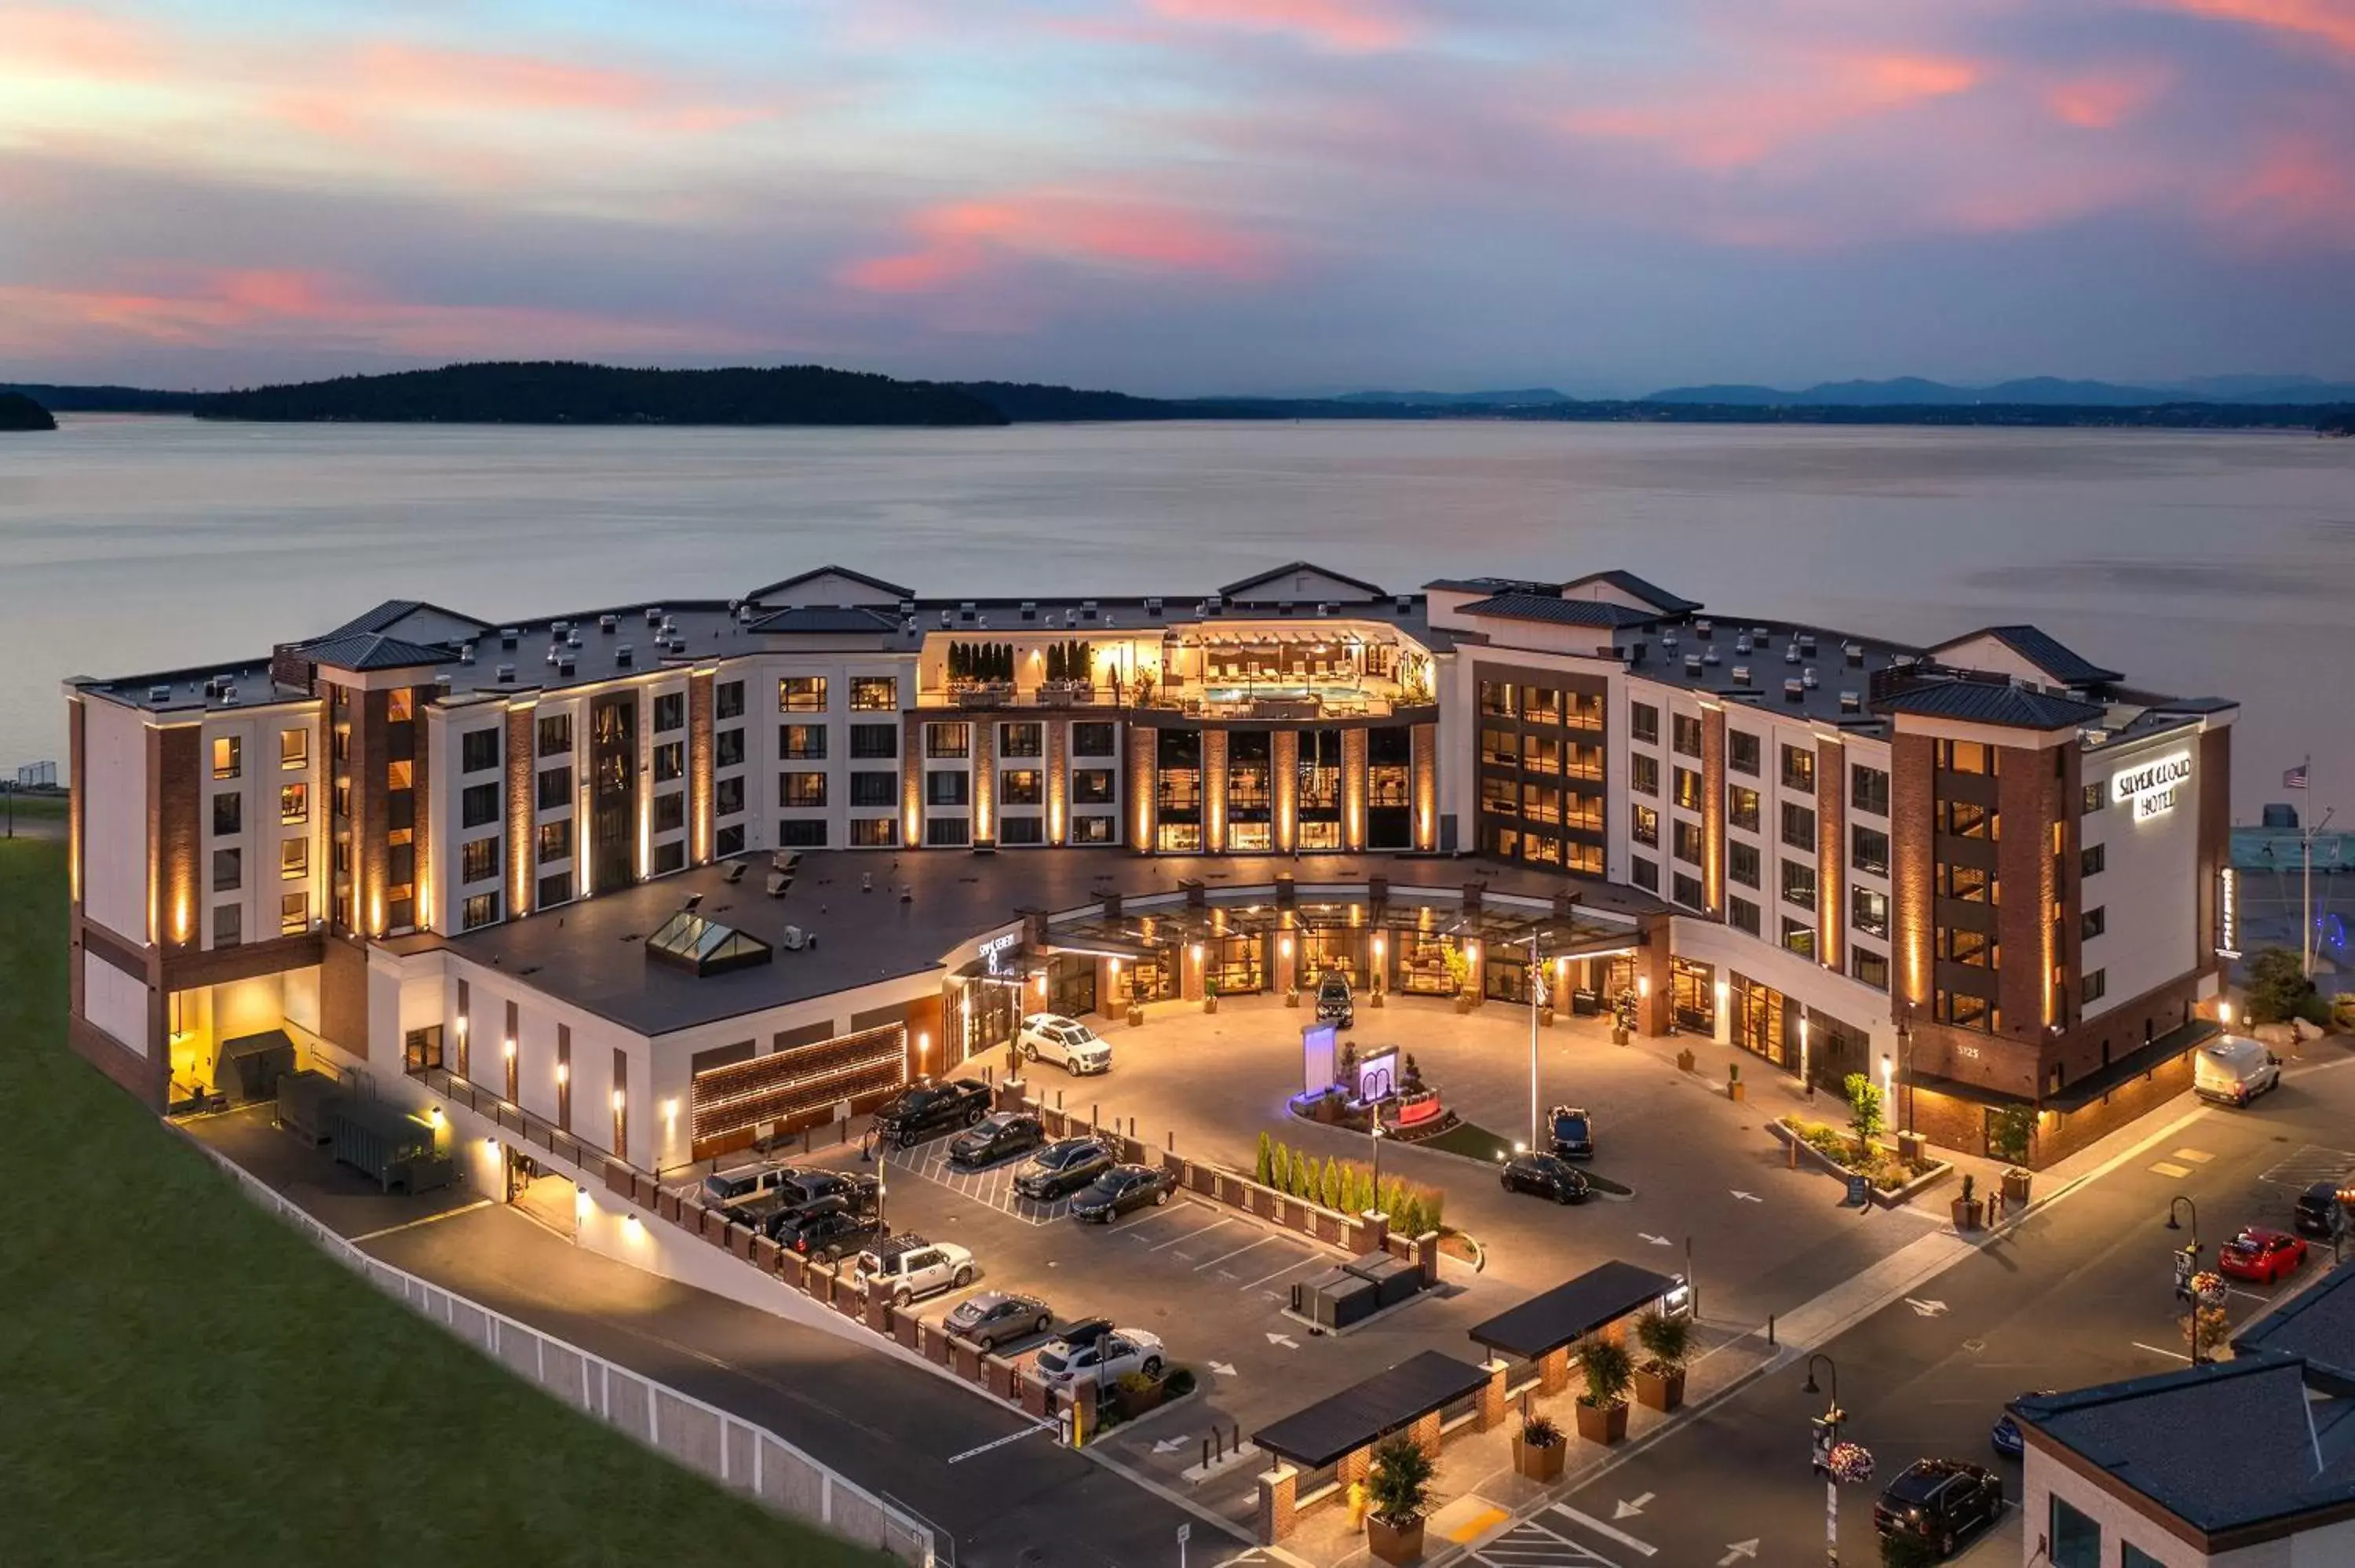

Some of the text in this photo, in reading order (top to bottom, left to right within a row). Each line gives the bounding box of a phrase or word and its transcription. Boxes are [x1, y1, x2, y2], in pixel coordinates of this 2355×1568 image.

[2120, 758, 2191, 797] SILVER CLOUD
[2141, 787, 2175, 816] HOTEL
